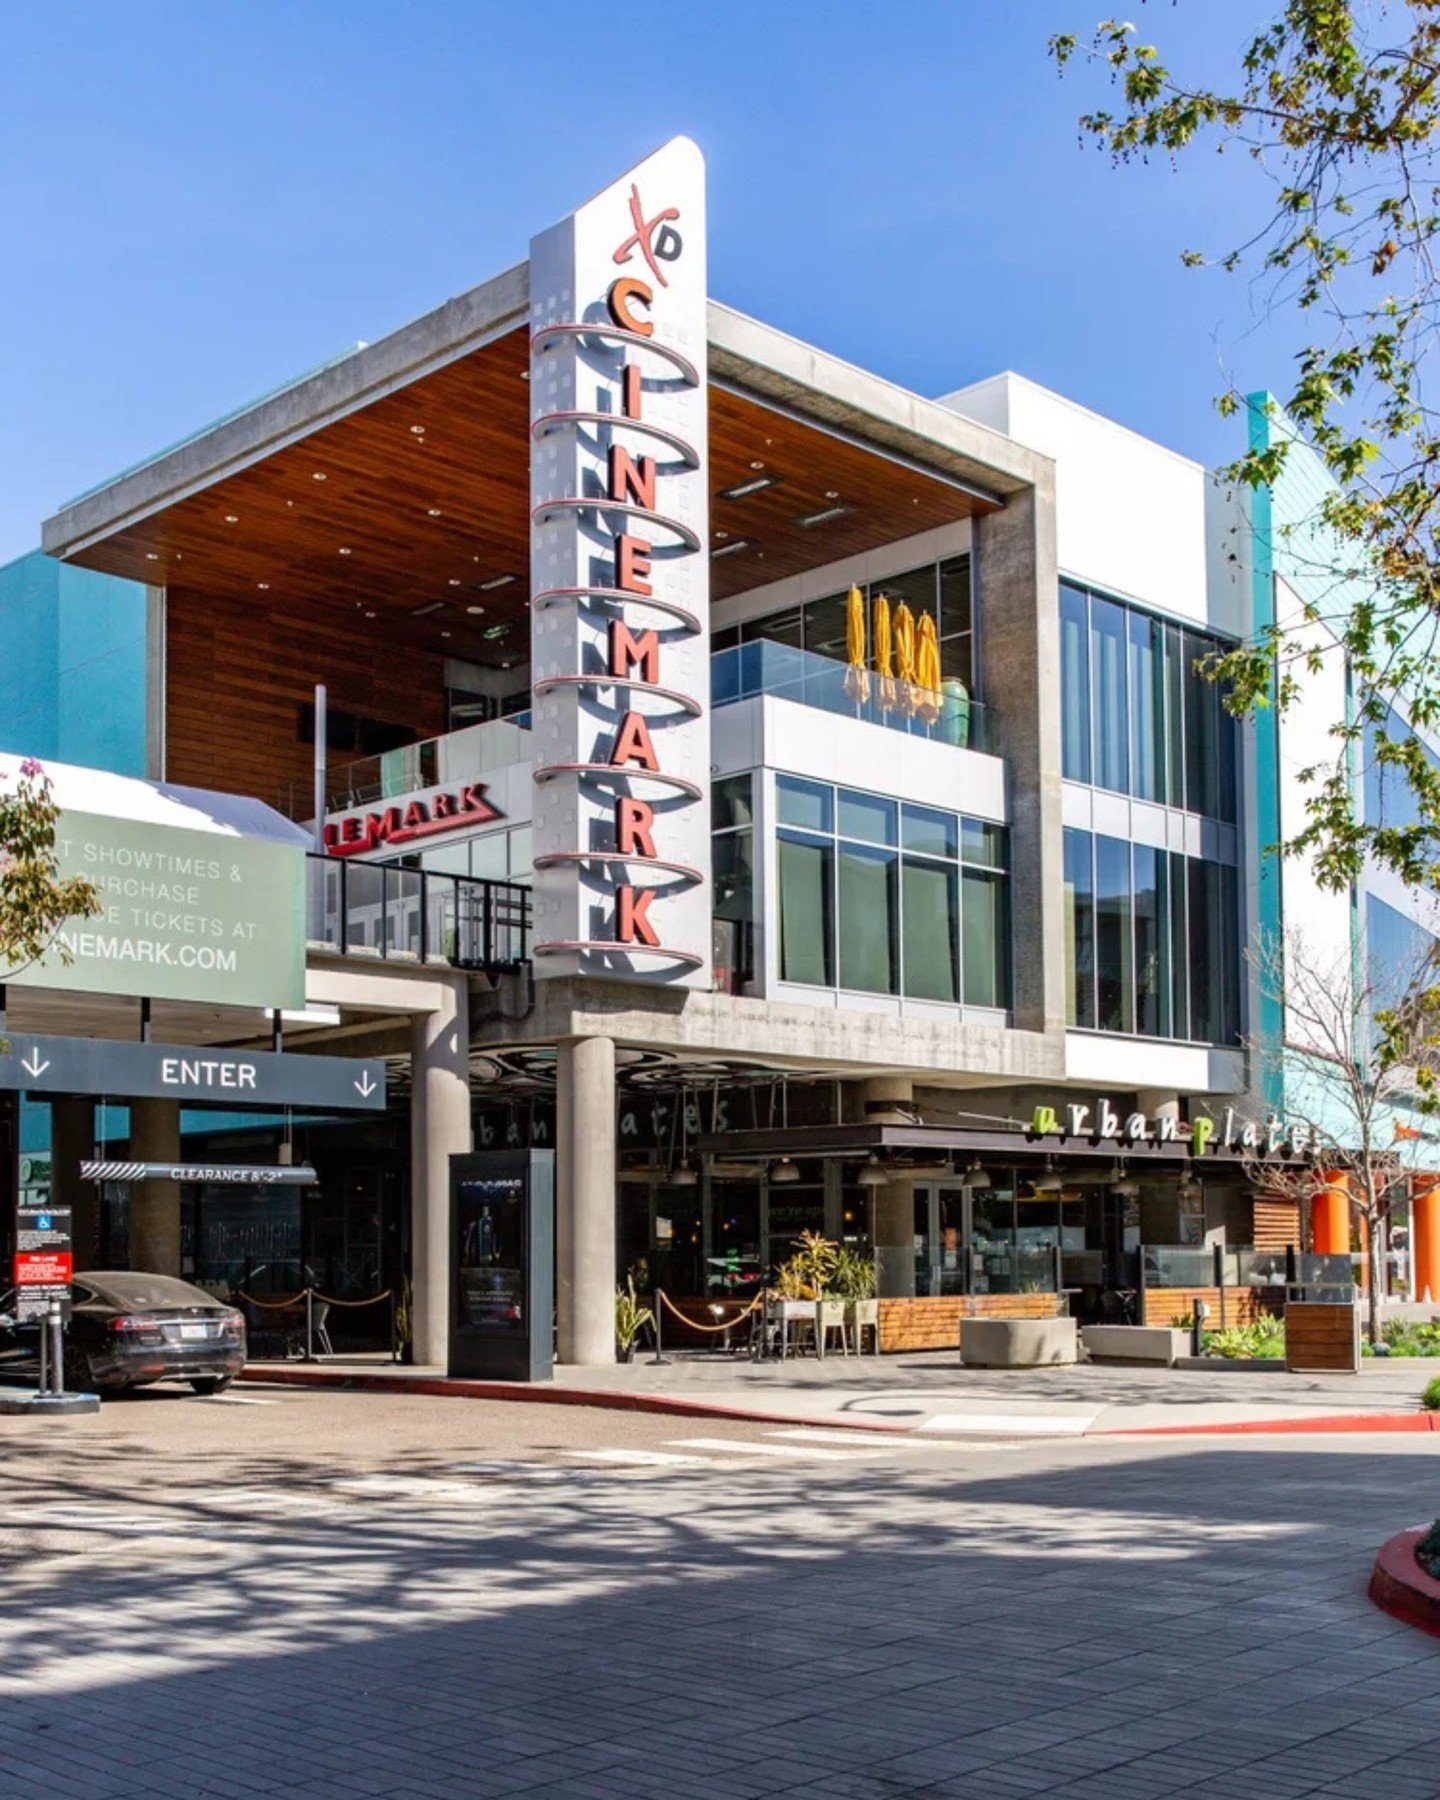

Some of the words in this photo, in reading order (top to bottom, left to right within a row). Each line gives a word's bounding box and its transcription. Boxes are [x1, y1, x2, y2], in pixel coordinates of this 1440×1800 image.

[607, 276, 660, 947] CINEMARK
[84, 843, 220, 880] SHOWTIMES
[230, 864, 242, 883] &
[130, 908, 223, 937] TICKETS
[232, 921, 257, 940] AT
[162, 1058, 257, 1088] ENTER
[1031, 1098, 1179, 1142] urban
[170, 1167, 248, 1183] CLEARANCE
